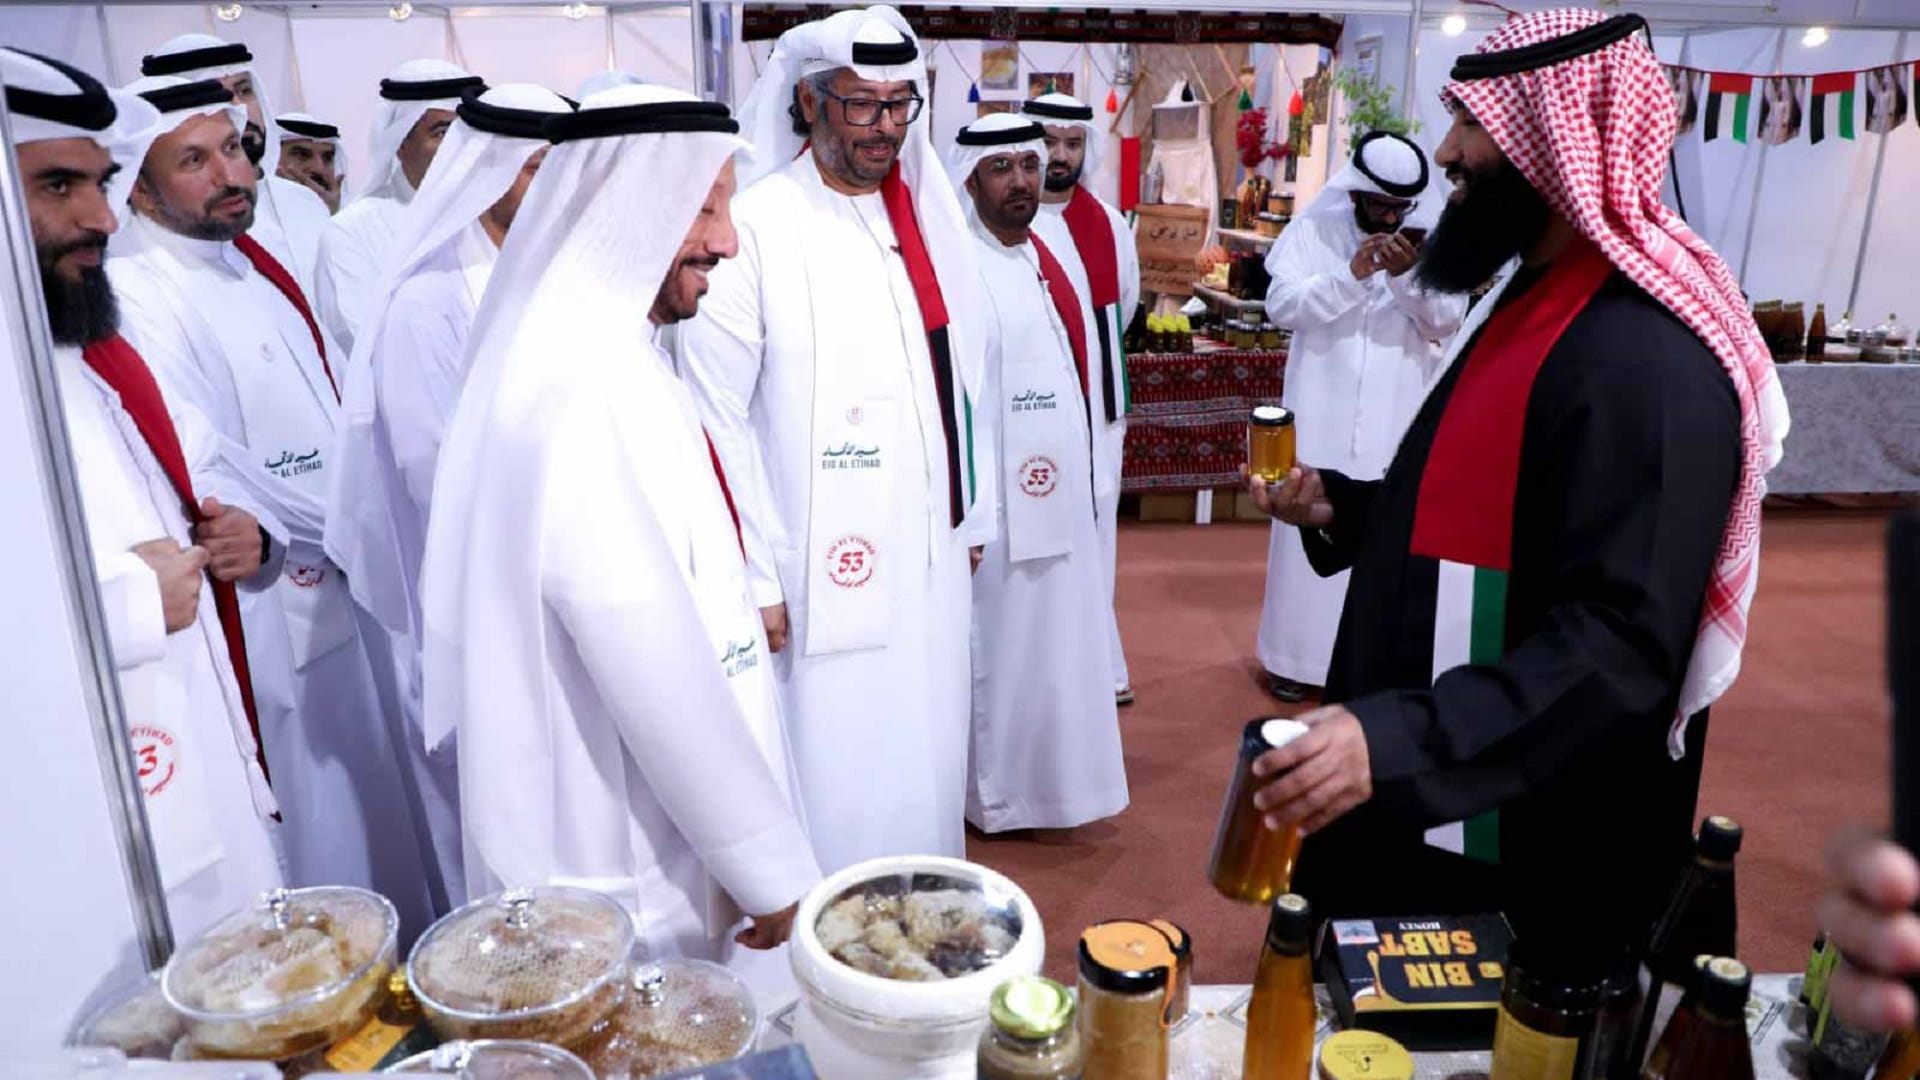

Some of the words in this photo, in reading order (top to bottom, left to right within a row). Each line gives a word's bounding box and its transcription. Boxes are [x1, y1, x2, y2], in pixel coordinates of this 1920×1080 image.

[280, 467, 291, 478] AL
[294, 460, 324, 475] ETIHAD
[822, 459, 836, 469] EID
[839, 459, 848, 469] AL
[851, 458, 881, 469] ETIHAD
[1028, 468, 1049, 486] 53
[837, 550, 865, 574] 53
[1398, 921, 1441, 931] HONEY
[1378, 930, 1478, 957] SABT
[1403, 960, 1476, 988] BIN
